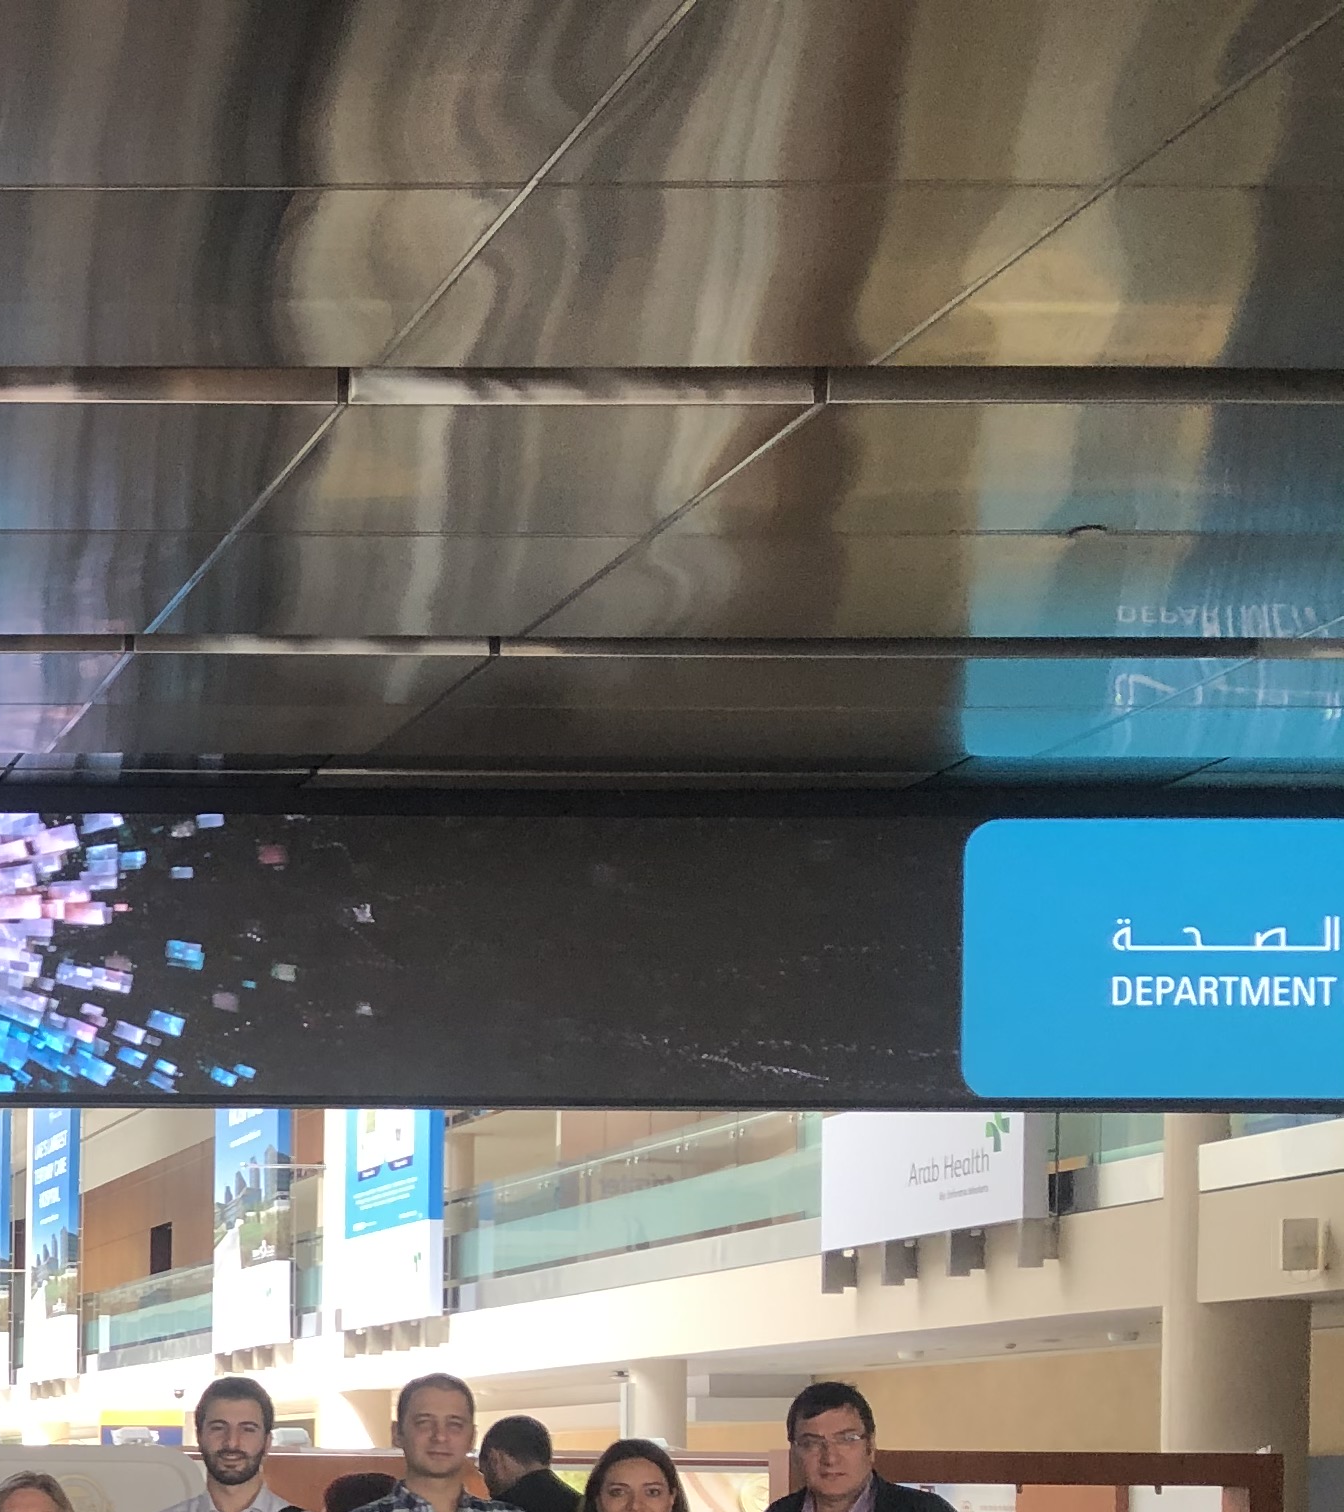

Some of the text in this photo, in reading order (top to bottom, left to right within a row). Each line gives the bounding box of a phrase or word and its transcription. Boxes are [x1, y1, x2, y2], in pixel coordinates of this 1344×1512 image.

[1111, 976, 1338, 1007] DEPARTMENT
[908, 1146, 990, 1187] Arab Health
